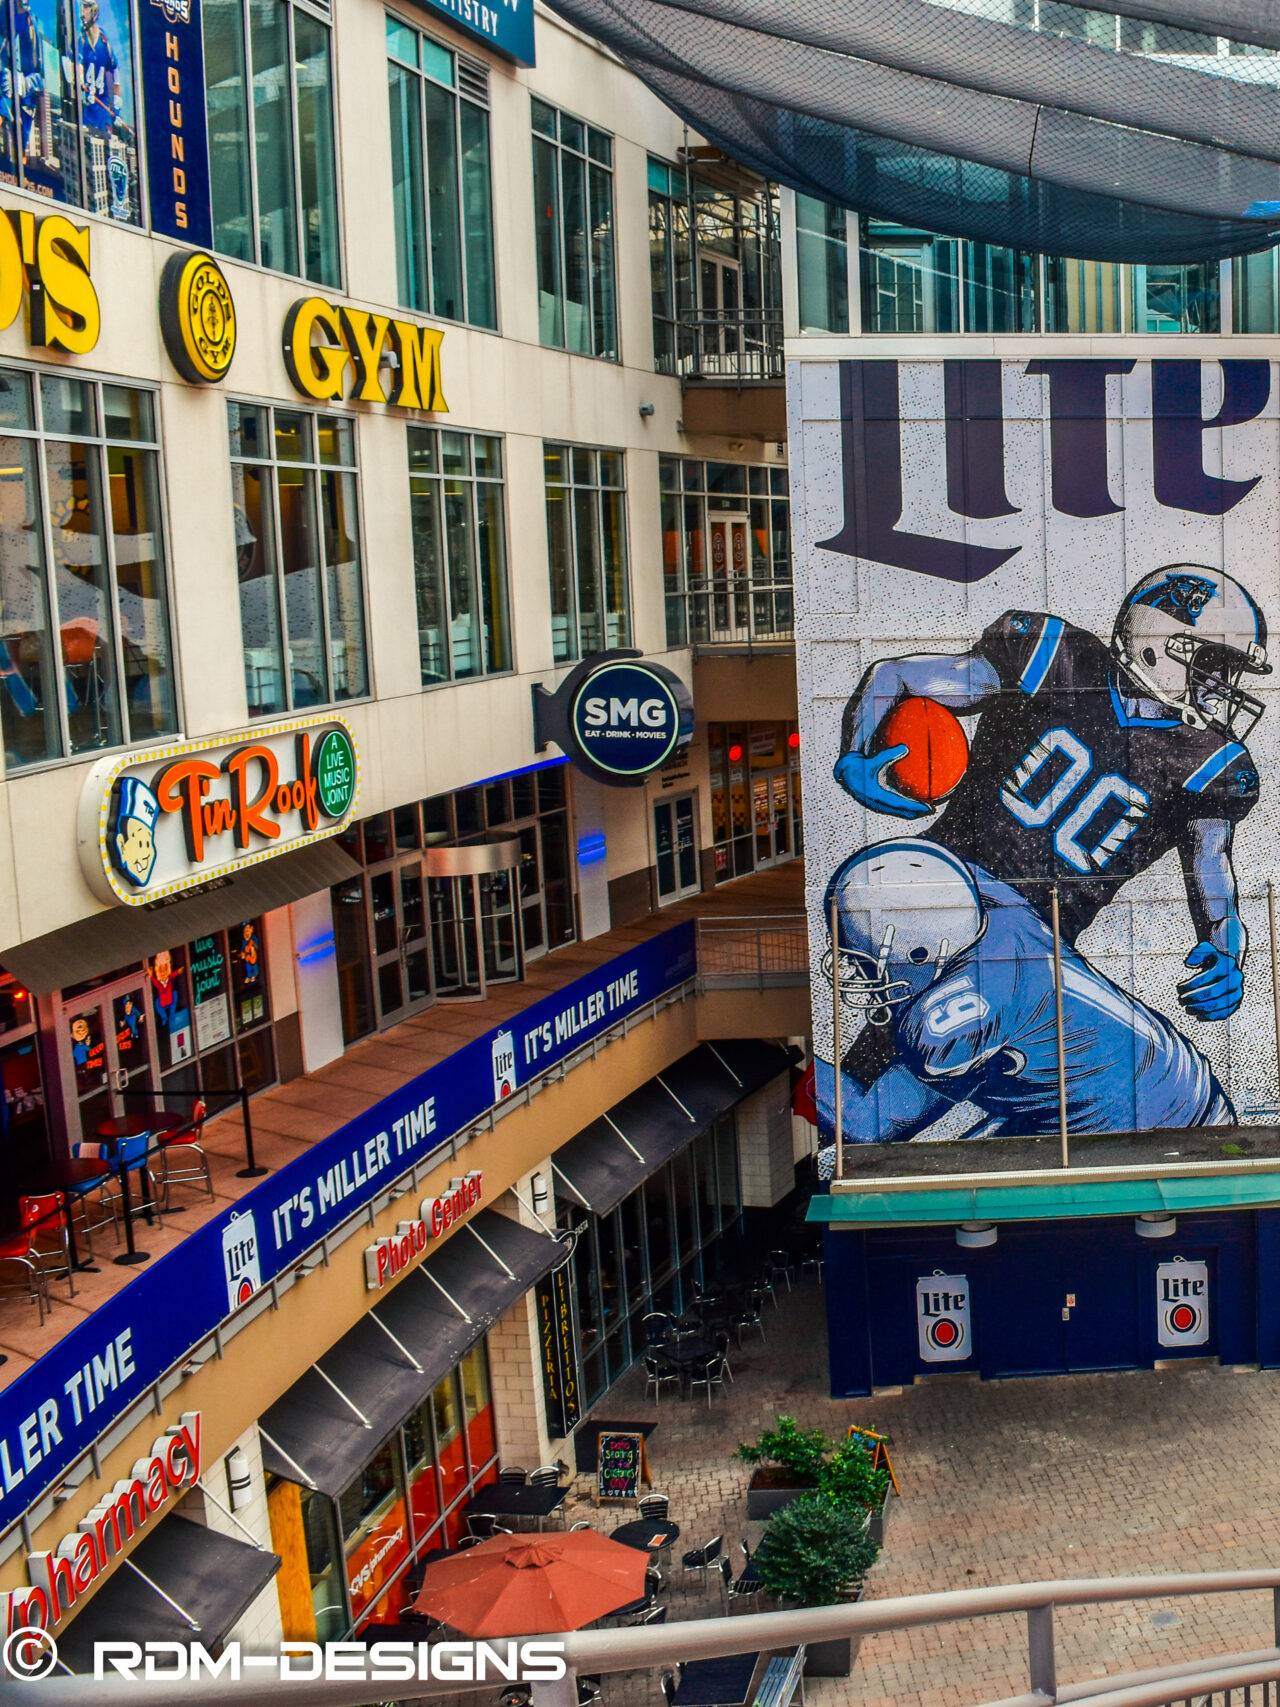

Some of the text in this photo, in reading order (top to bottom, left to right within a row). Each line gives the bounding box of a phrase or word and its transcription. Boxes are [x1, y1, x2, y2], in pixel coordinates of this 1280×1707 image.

[165, 32, 188, 229] HOUNDS
[286, 297, 450, 413] GYM
[815, 359, 1271, 583] Lite
[584, 698, 667, 727] SMG
[585, 730, 667, 740] EAT DRINK MOVIES
[326, 752, 345, 768] LIVE
[331, 735, 339, 749] A
[156, 733, 319, 863] Tin Roof
[323, 768, 351, 786] MUSIC
[325, 788, 349, 806] JOINT
[524, 969, 639, 1064] IT'S MILLER TIME
[494, 1051, 512, 1081] Lite
[272, 1096, 437, 1250] IT'S MILLER TIME
[373, 1172, 482, 1289] Photo Center
[226, 1236, 255, 1283] Lite
[920, 1291, 967, 1318] Lite
[1160, 1276, 1205, 1303] Lite
[541, 1295, 558, 1400] PIZZERIA
[64, 1326, 136, 1427] TIME
